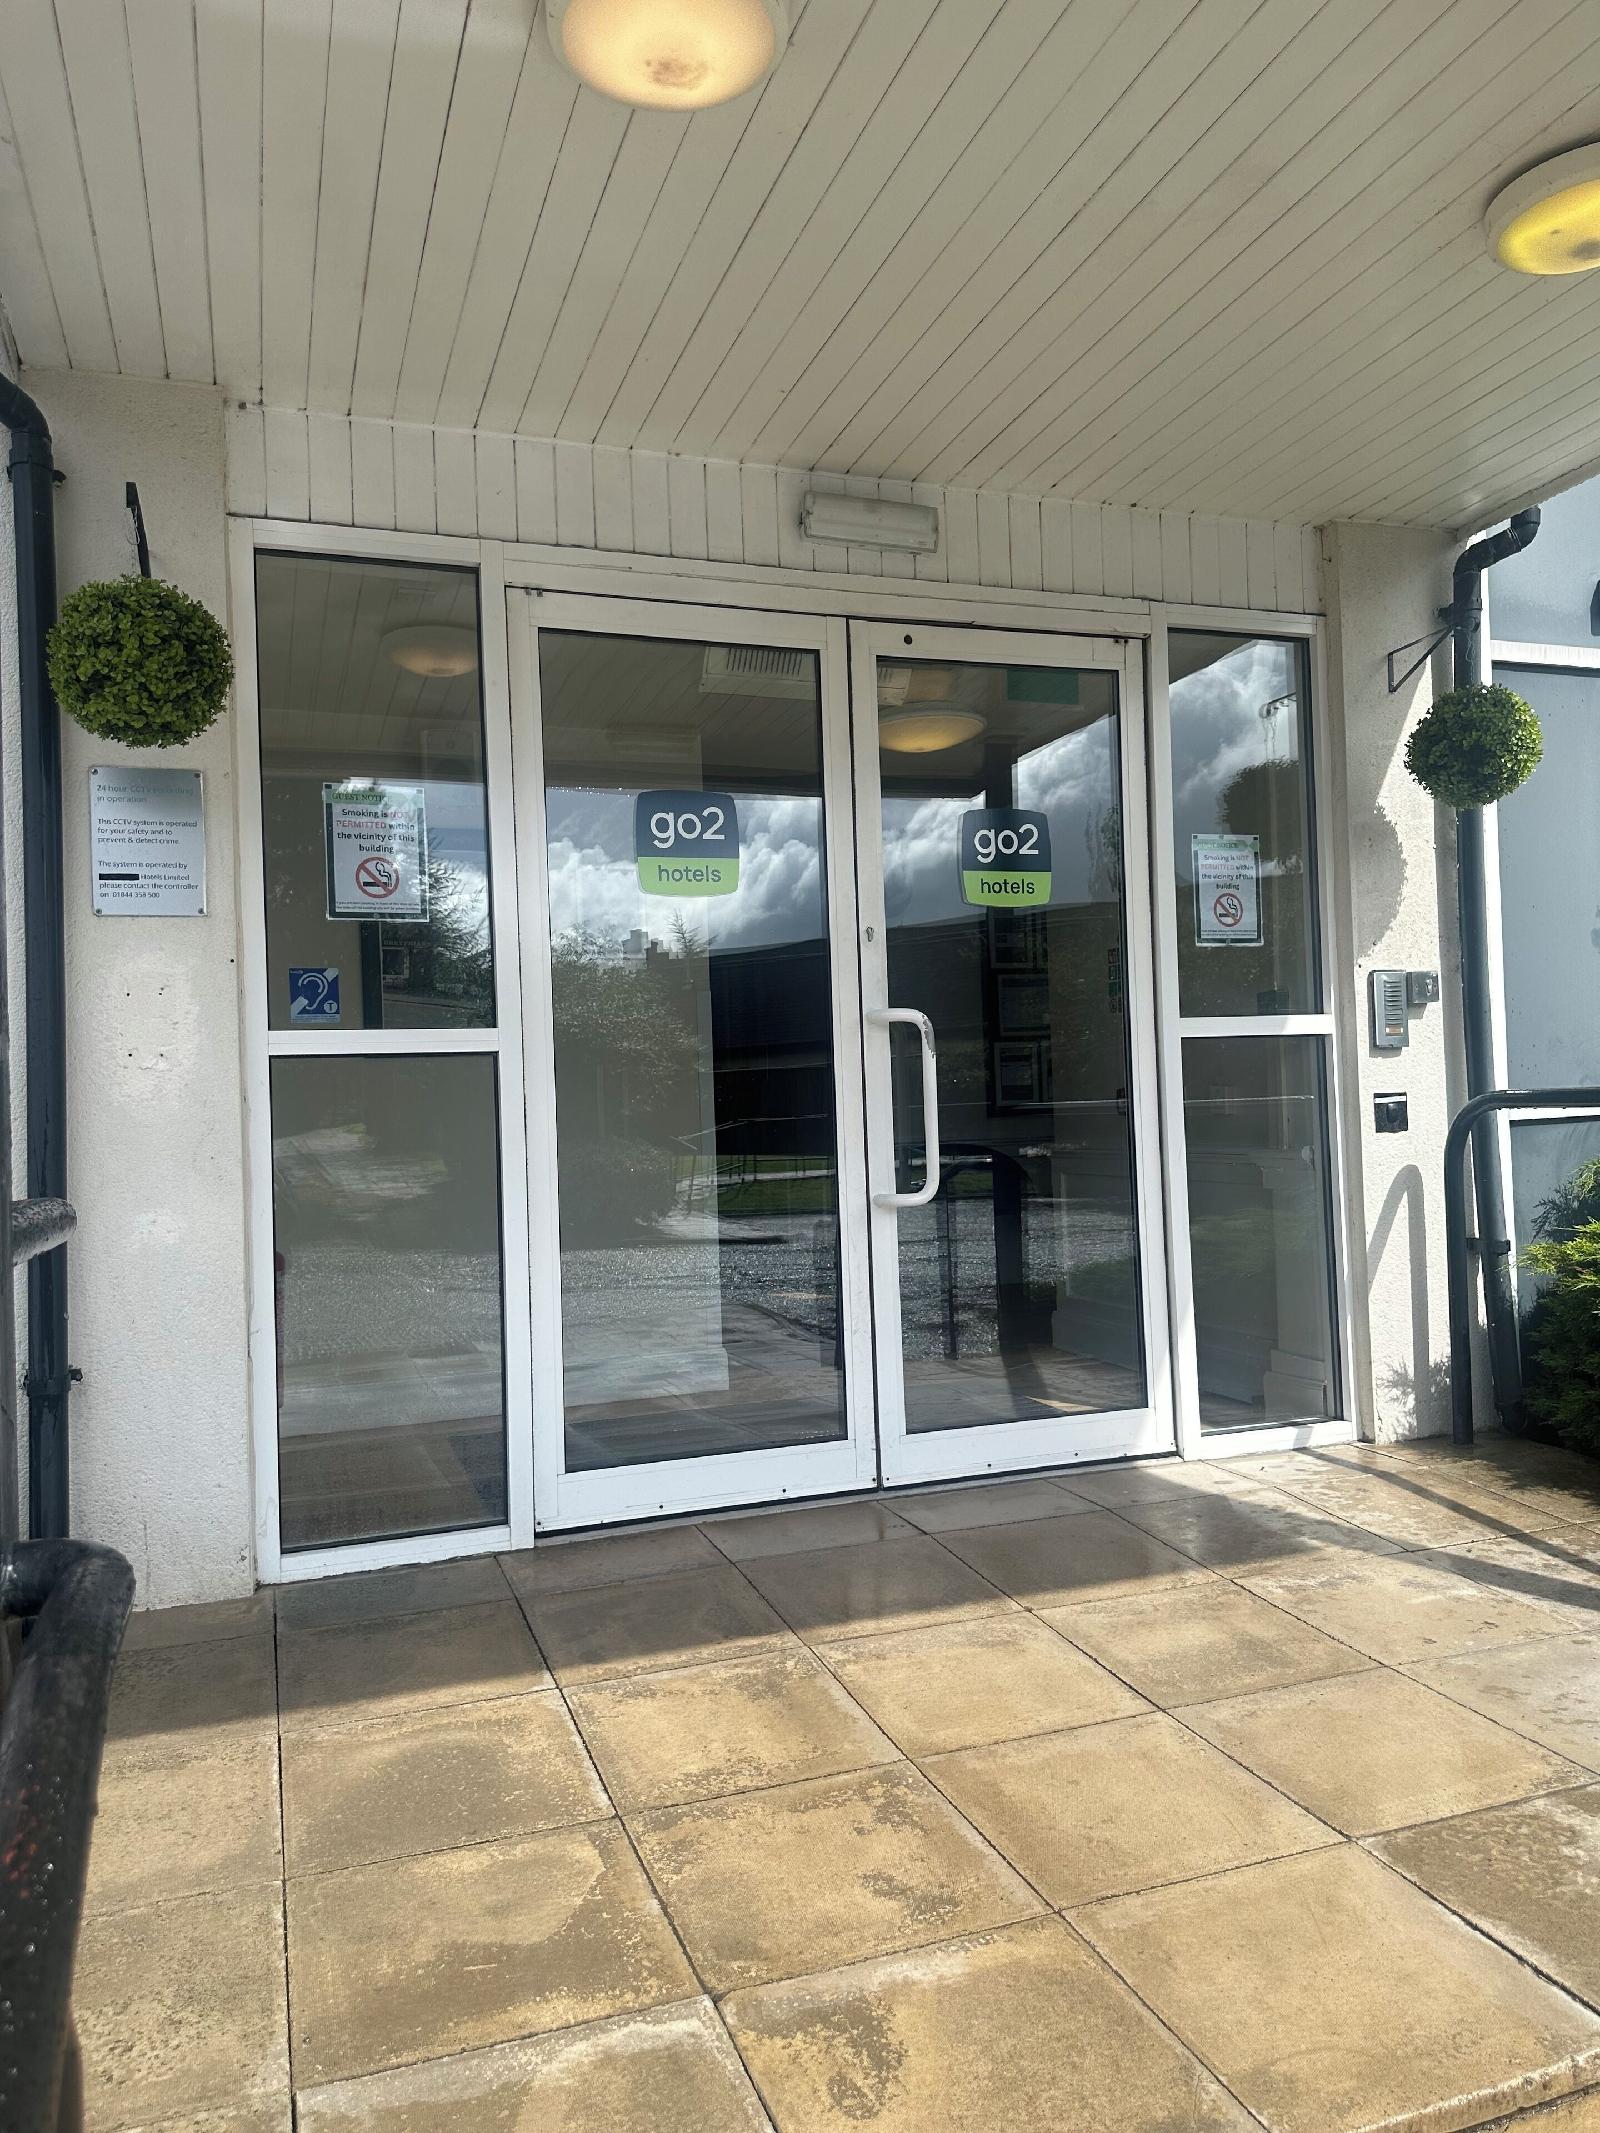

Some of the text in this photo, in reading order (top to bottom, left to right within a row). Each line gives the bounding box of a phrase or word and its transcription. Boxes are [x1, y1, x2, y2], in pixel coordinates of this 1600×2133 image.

[97, 784, 107, 793] 24
[108, 785, 127, 793] hour
[342, 808, 379, 819] Smoking
[381, 810, 388, 818] is
[133, 819, 157, 827] system
[165, 820, 198, 828] operated
[336, 820, 415, 830] PERMITTED within
[650, 806, 725, 848] go2
[127, 828, 149, 836] safety
[98, 837, 127, 845] prevent
[337, 832, 415, 843] the vicinity of this
[974, 823, 1039, 863] go2
[359, 844, 394, 854] building
[1204, 854, 1229, 862] Smoking
[112, 861, 138, 869] system
[145, 861, 178, 869] operated
[179, 862, 187, 870] by
[140, 873, 163, 881] Hotels
[657, 864, 722, 883] hotels
[1213, 873, 1234, 881] vicinity
[99, 882, 122, 890] please
[123, 882, 150, 890] contact
[980, 878, 1036, 895] hotels
[1216, 883, 1240, 891] building
[327, 1002, 334, 1011] T
